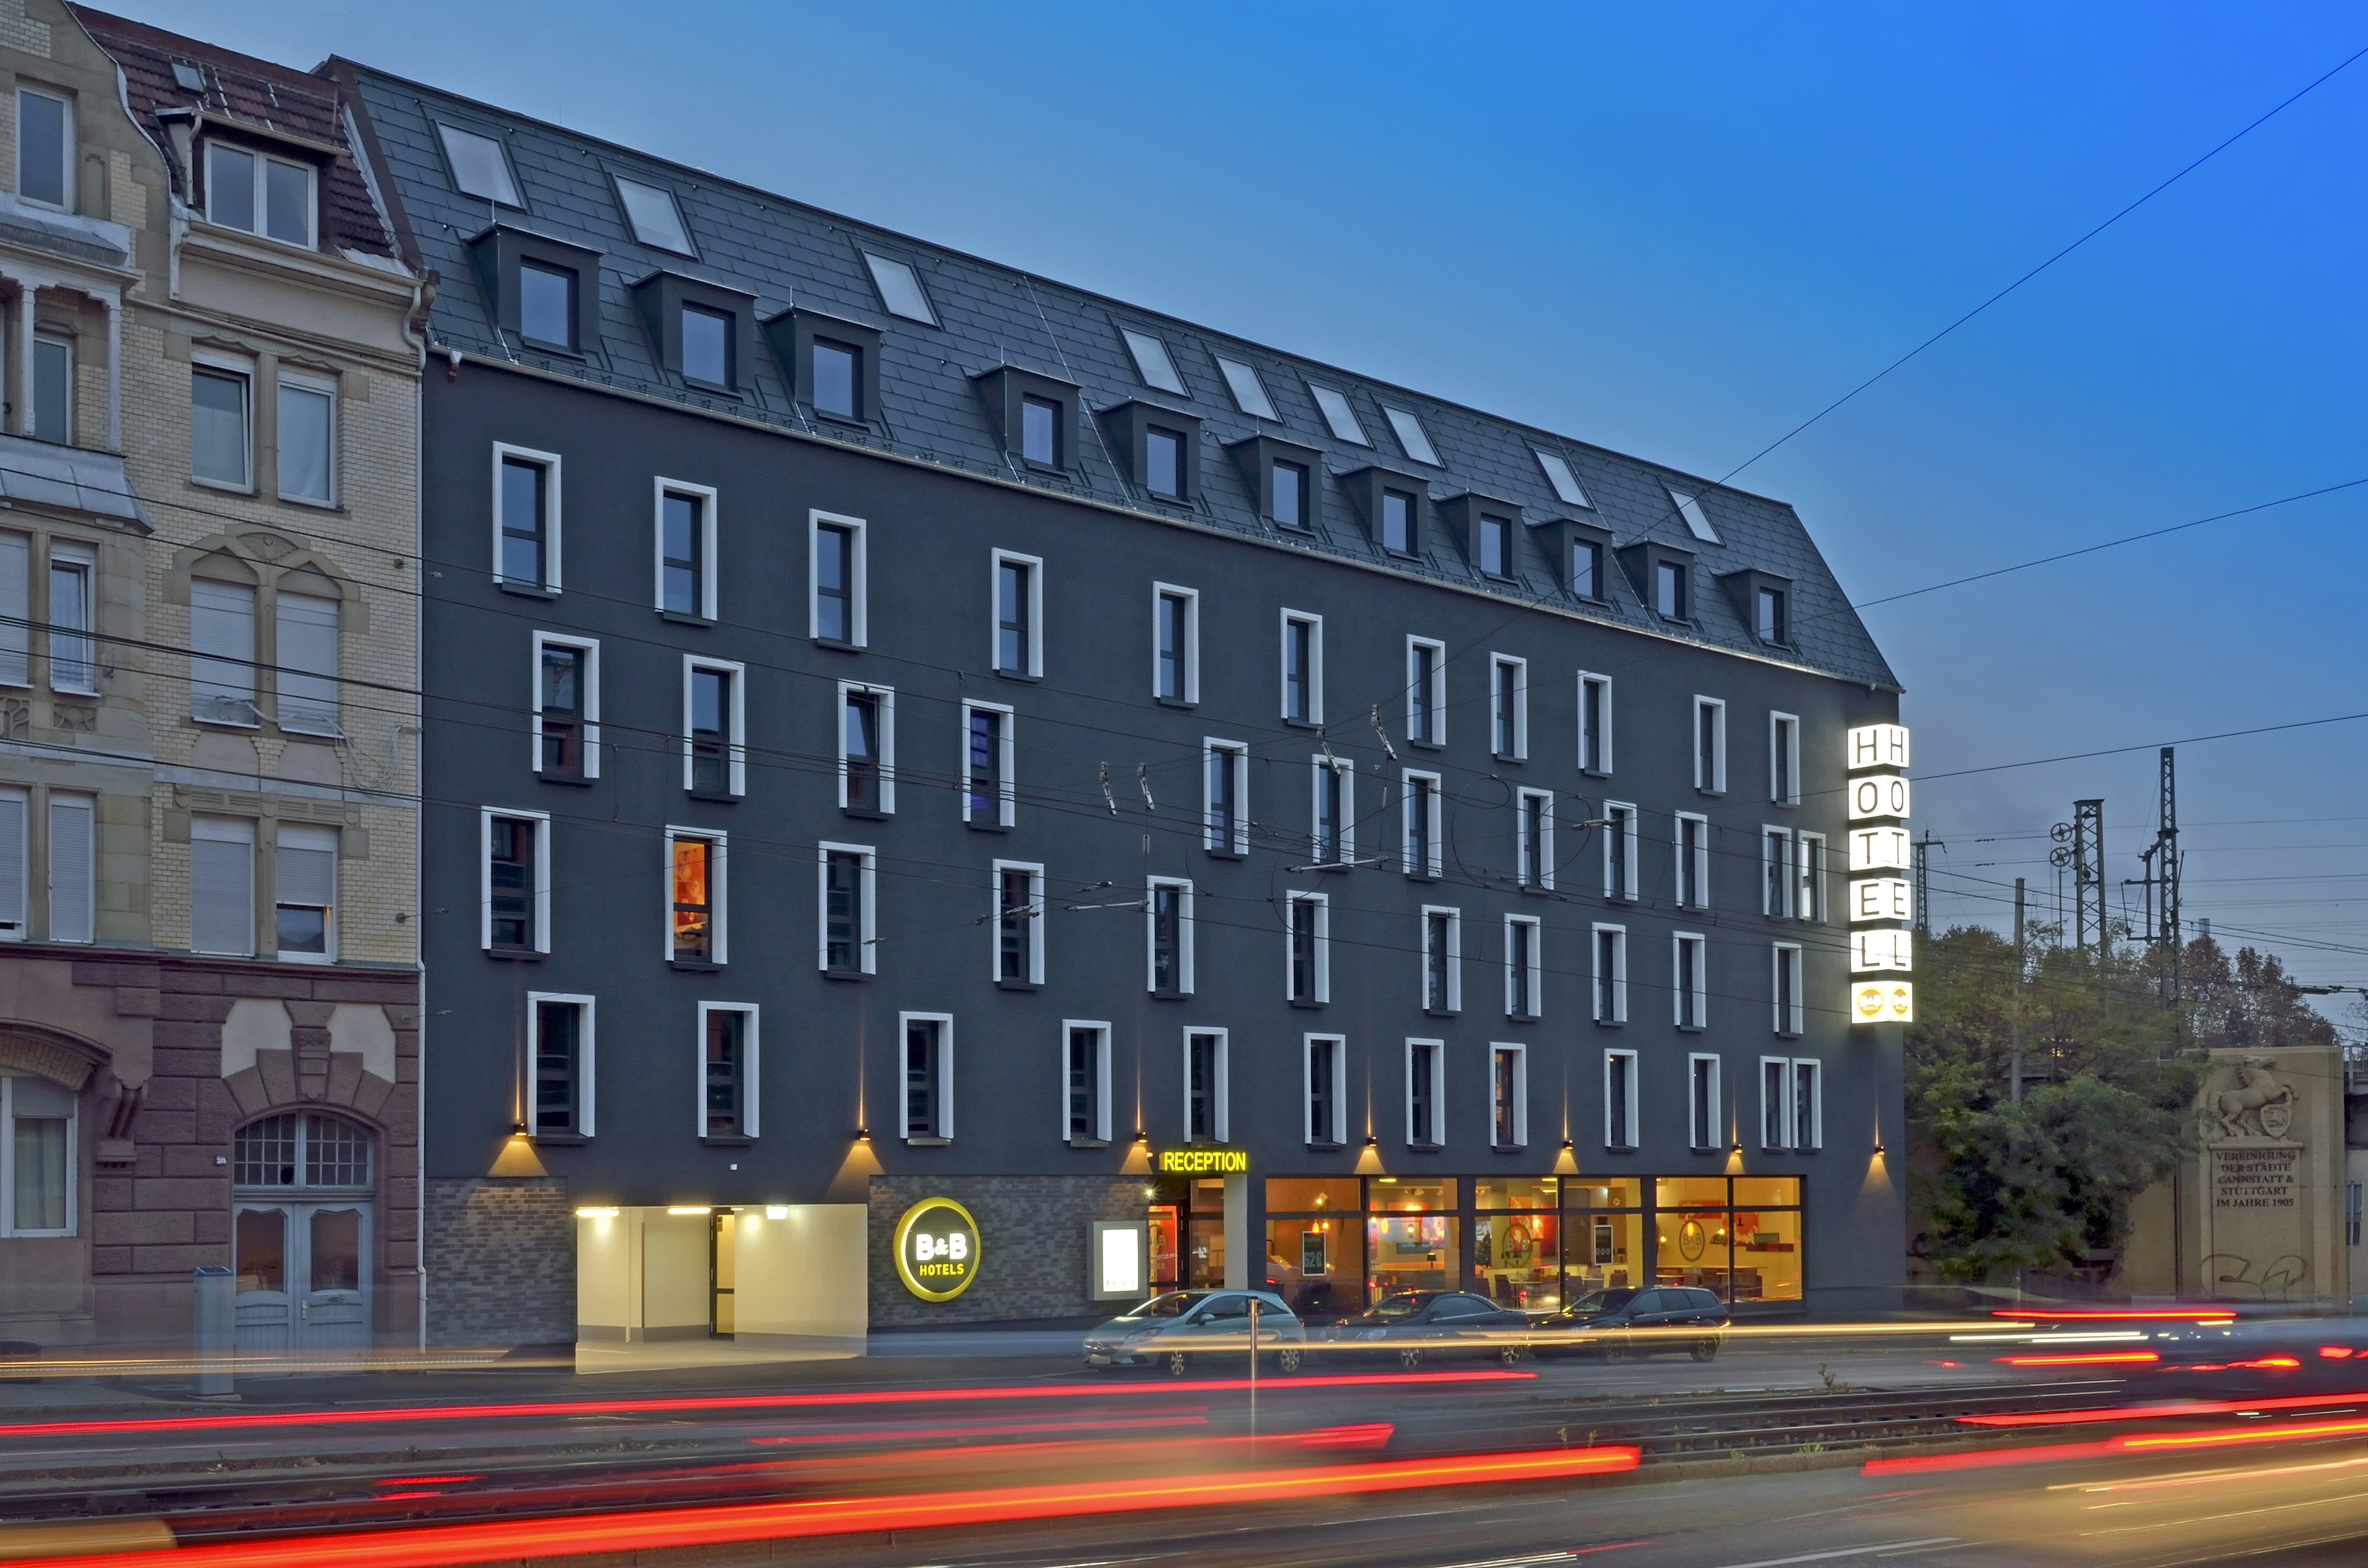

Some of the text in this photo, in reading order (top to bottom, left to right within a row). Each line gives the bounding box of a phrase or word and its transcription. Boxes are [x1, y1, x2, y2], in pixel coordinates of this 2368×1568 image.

[1856, 729, 1880, 968] HOTEL
[1890, 729, 1907, 967] HOTEL
[1164, 1152, 1246, 1171] RECEPTION
[2216, 1152, 2296, 1160] VEREINIGUNG
[2218, 1175, 2283, 1184] CANNSTATT
[2221, 1186, 2289, 1196] STUTTGART
[2216, 1198, 2294, 1208] IM JAHRE 1905
[916, 1233, 967, 1261] B&B
[919, 1263, 965, 1276] HOTELS
